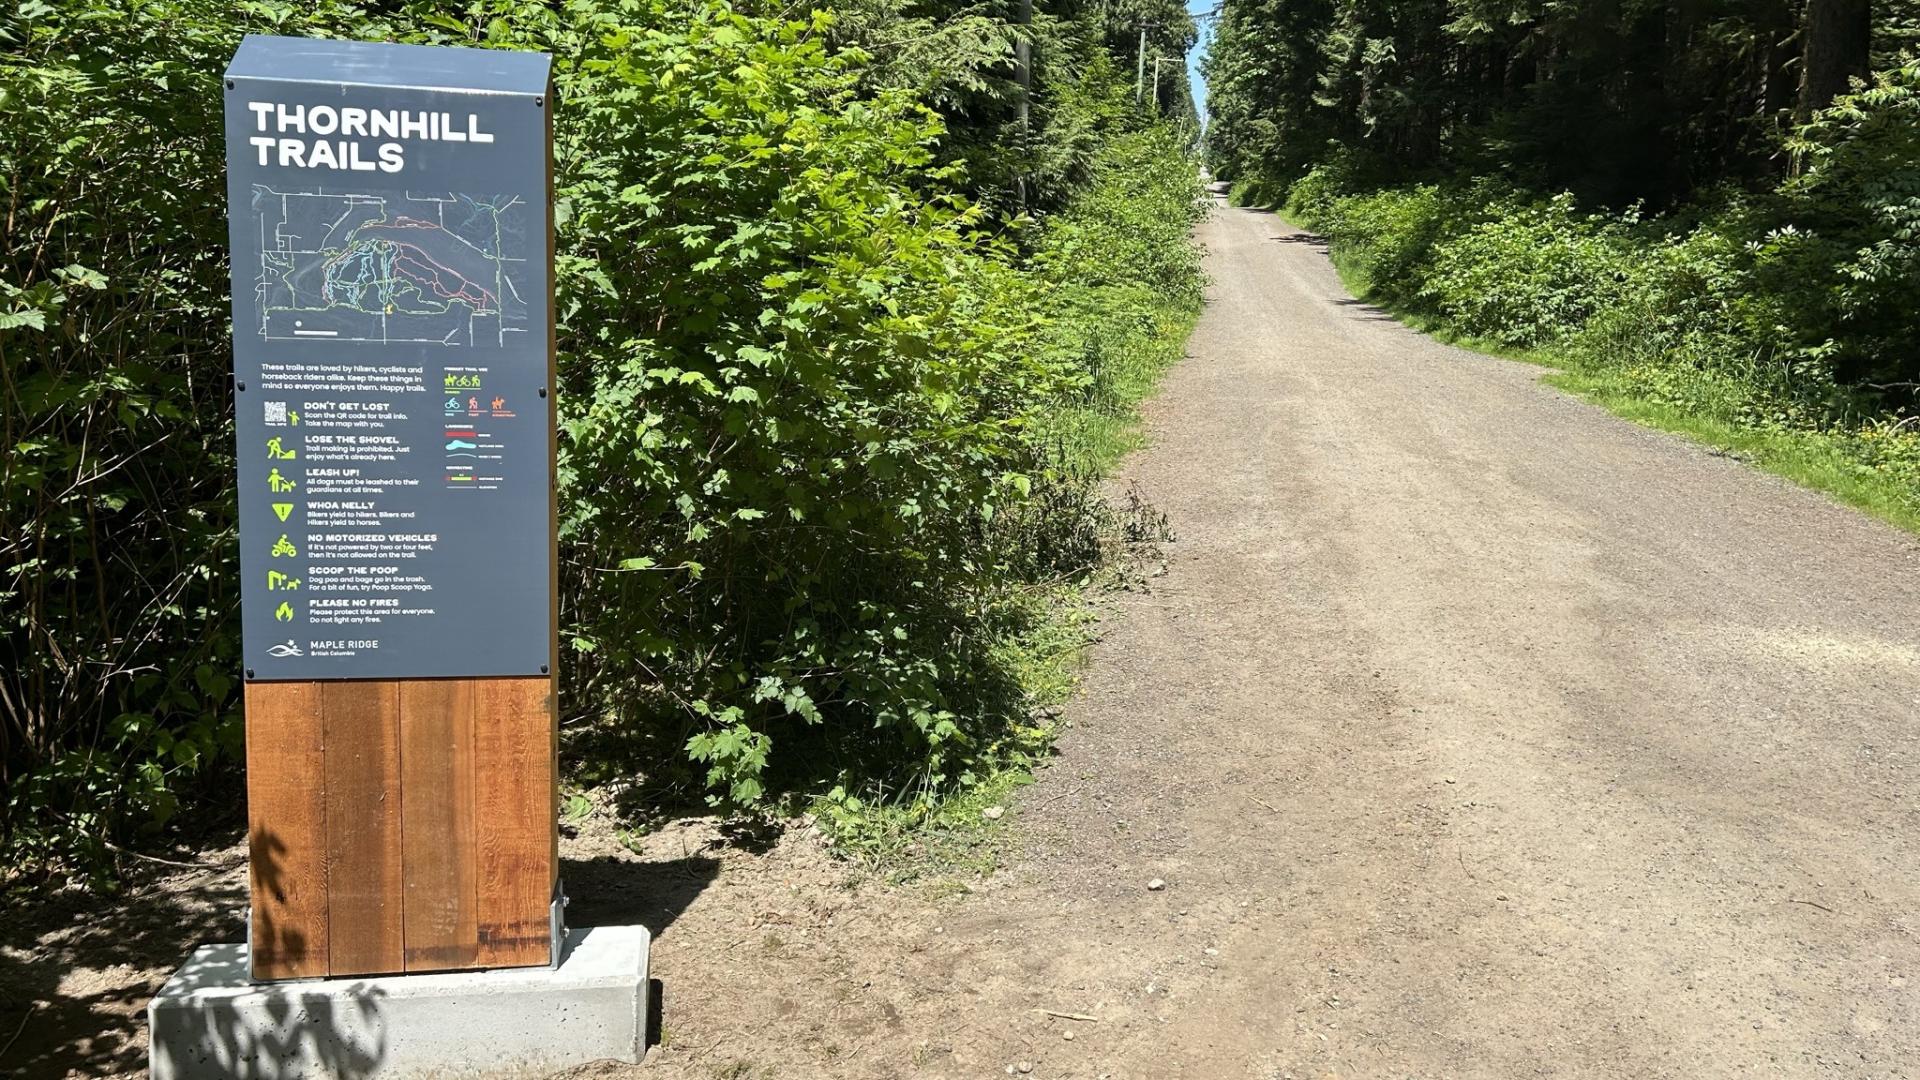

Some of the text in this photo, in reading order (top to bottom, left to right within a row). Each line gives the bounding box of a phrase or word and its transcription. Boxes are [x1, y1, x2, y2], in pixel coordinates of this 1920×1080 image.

[248, 102, 494, 144] THORNHILL
[250, 136, 404, 173] TRAILS
[348, 374, 366, 383] Keep
[390, 375, 413, 384] things
[295, 383, 329, 392] everyone
[331, 383, 355, 392] enjoys
[380, 385, 404, 393] Happy
[304, 401, 336, 410] DON'T
[348, 640, 378, 648] RIDGE
